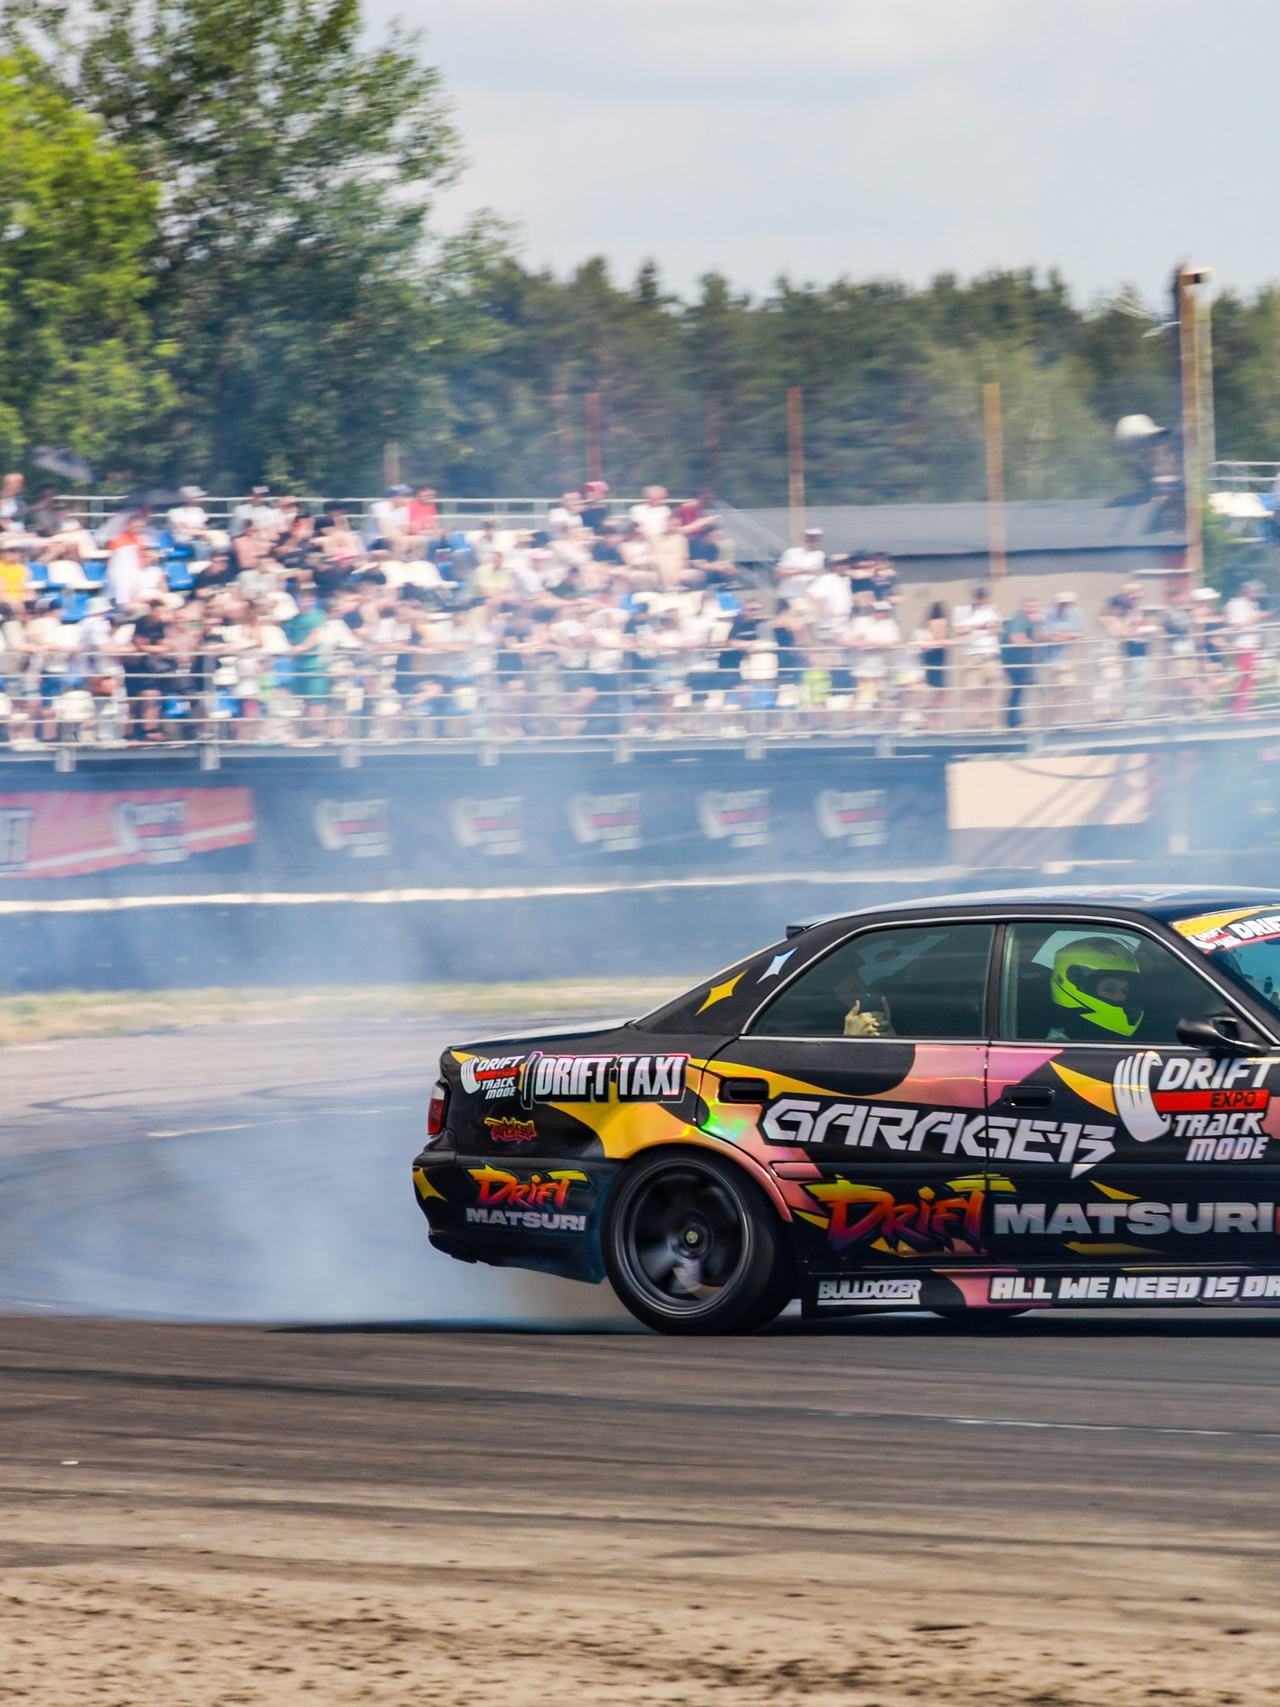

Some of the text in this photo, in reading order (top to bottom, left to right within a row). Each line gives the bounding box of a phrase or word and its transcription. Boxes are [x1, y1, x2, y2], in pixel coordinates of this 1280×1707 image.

[476, 1055, 526, 1072] DRIFT
[535, 1055, 687, 1096] DRIFT TAXI
[481, 1077, 515, 1091] TRACK
[485, 1086, 517, 1100] MODE
[1210, 1091, 1257, 1109] EXPO
[1173, 1112, 1265, 1137] TRACK
[1186, 1136, 1270, 1162] MODE
[465, 1207, 587, 1231] MATSURI
[994, 1201, 1275, 1235] MATSURI
[817, 1279, 922, 1299] BULLDOZER
[990, 1277, 1053, 1300] ALL
[1058, 1276, 1110, 1299] WE
[1112, 1276, 1202, 1299] NEED
[1202, 1275, 1241, 1298] IS
